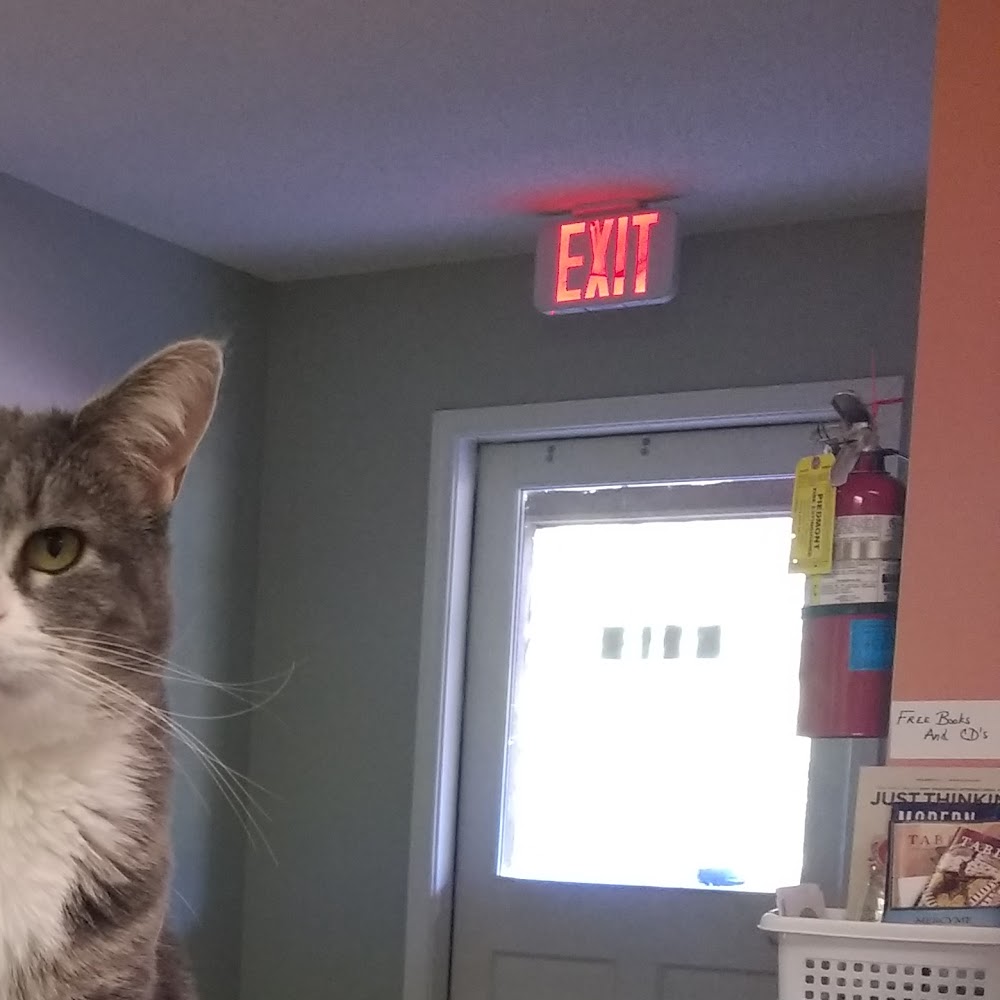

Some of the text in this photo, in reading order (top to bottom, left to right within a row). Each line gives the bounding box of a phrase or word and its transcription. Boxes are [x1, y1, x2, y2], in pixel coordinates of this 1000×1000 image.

[556, 212, 659, 303] EXIT
[813, 493, 825, 551] PIEDMONT
[896, 710, 971, 726] FREE Books
[923, 727, 989, 741] And CD's
[870, 791, 1000, 806] JUST THINKIN
